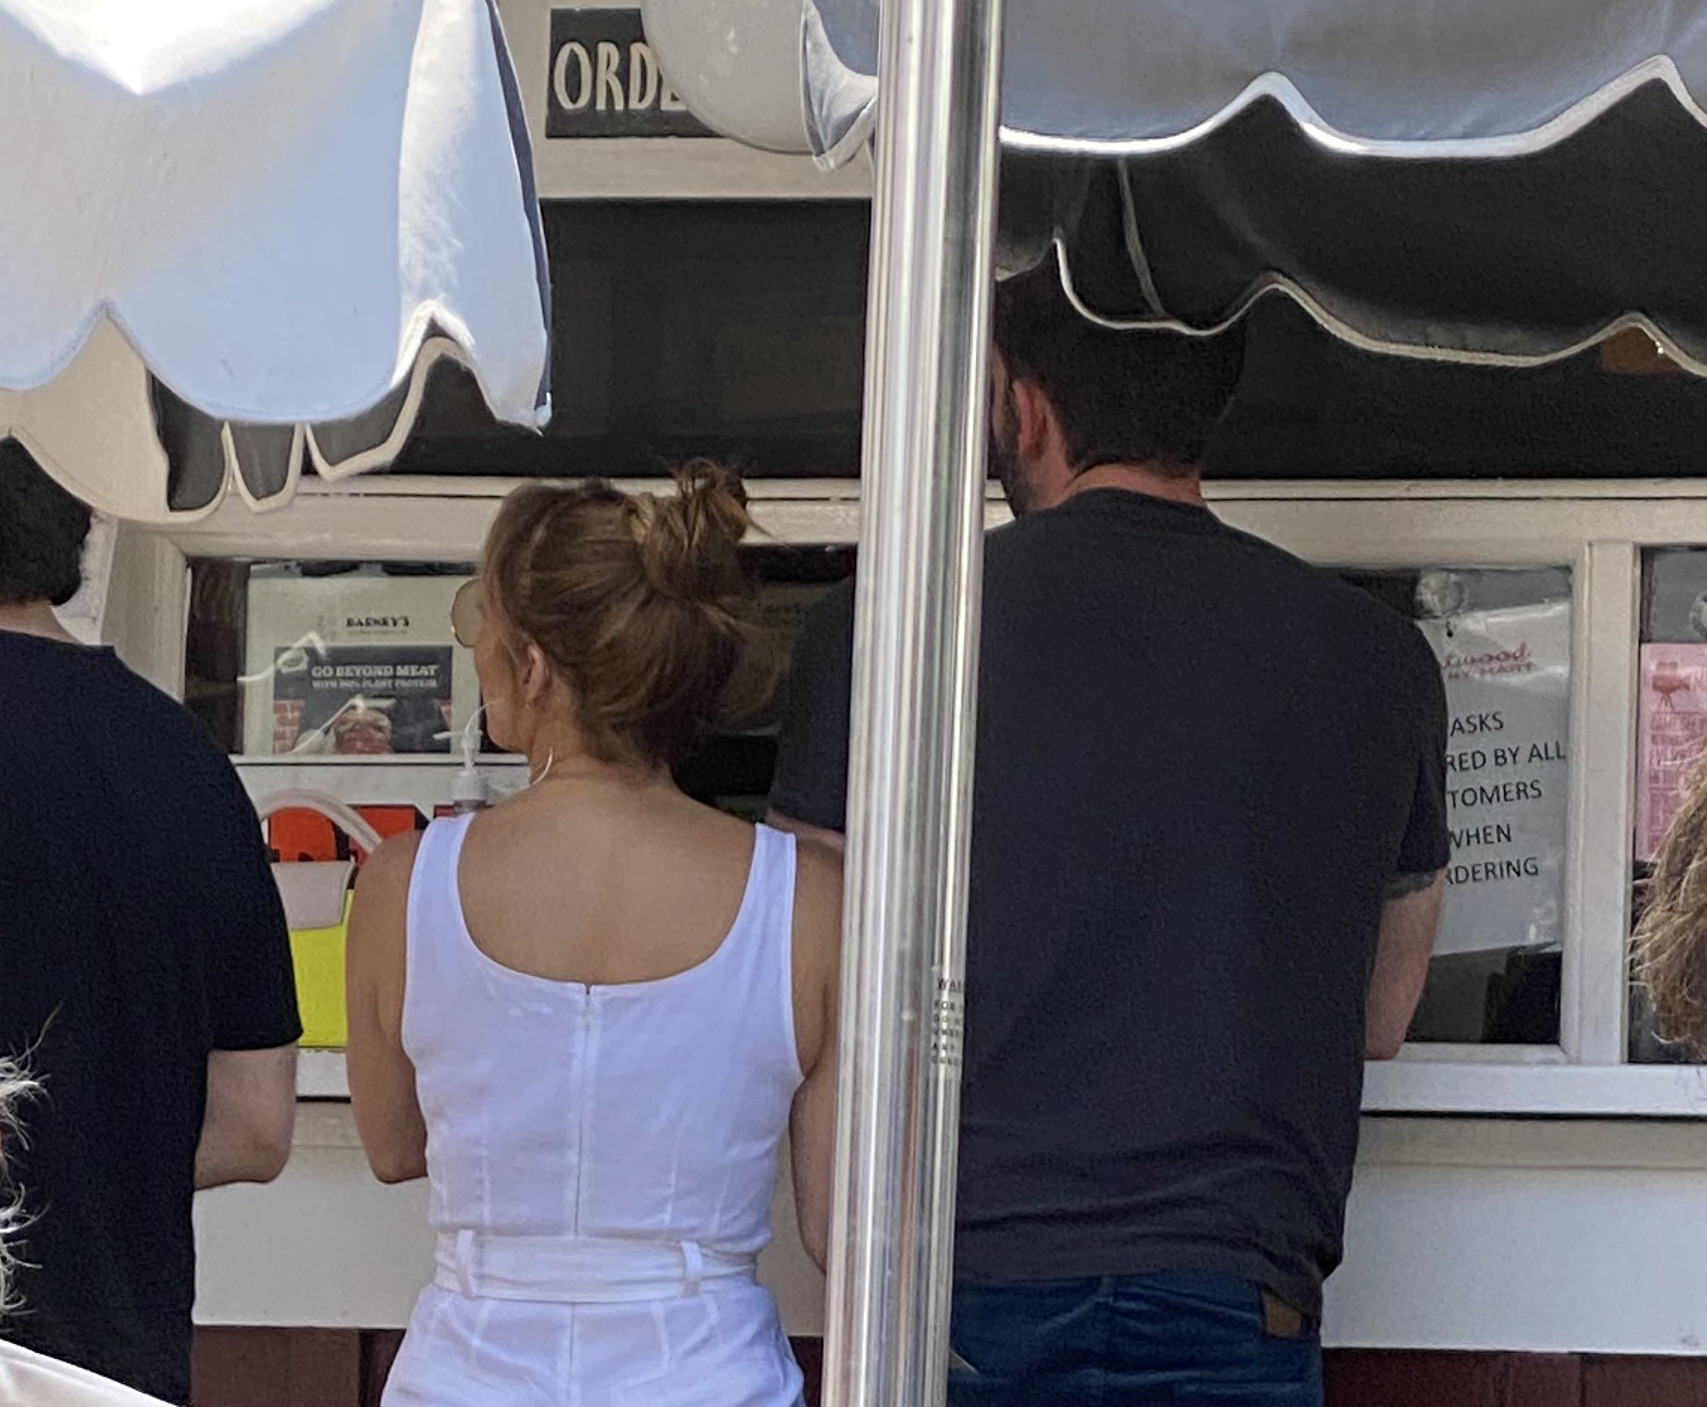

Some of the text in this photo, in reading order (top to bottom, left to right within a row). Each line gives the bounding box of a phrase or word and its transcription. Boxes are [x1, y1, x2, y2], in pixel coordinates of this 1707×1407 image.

[311, 664, 439, 677] GO BEYOND MEAT
[1450, 711, 1505, 737] ASKS
[1494, 746, 1520, 767] BY
[1528, 740, 1567, 763] ALL
[1447, 779, 1542, 809] TOMERS
[1450, 823, 1512, 849] WHEN
